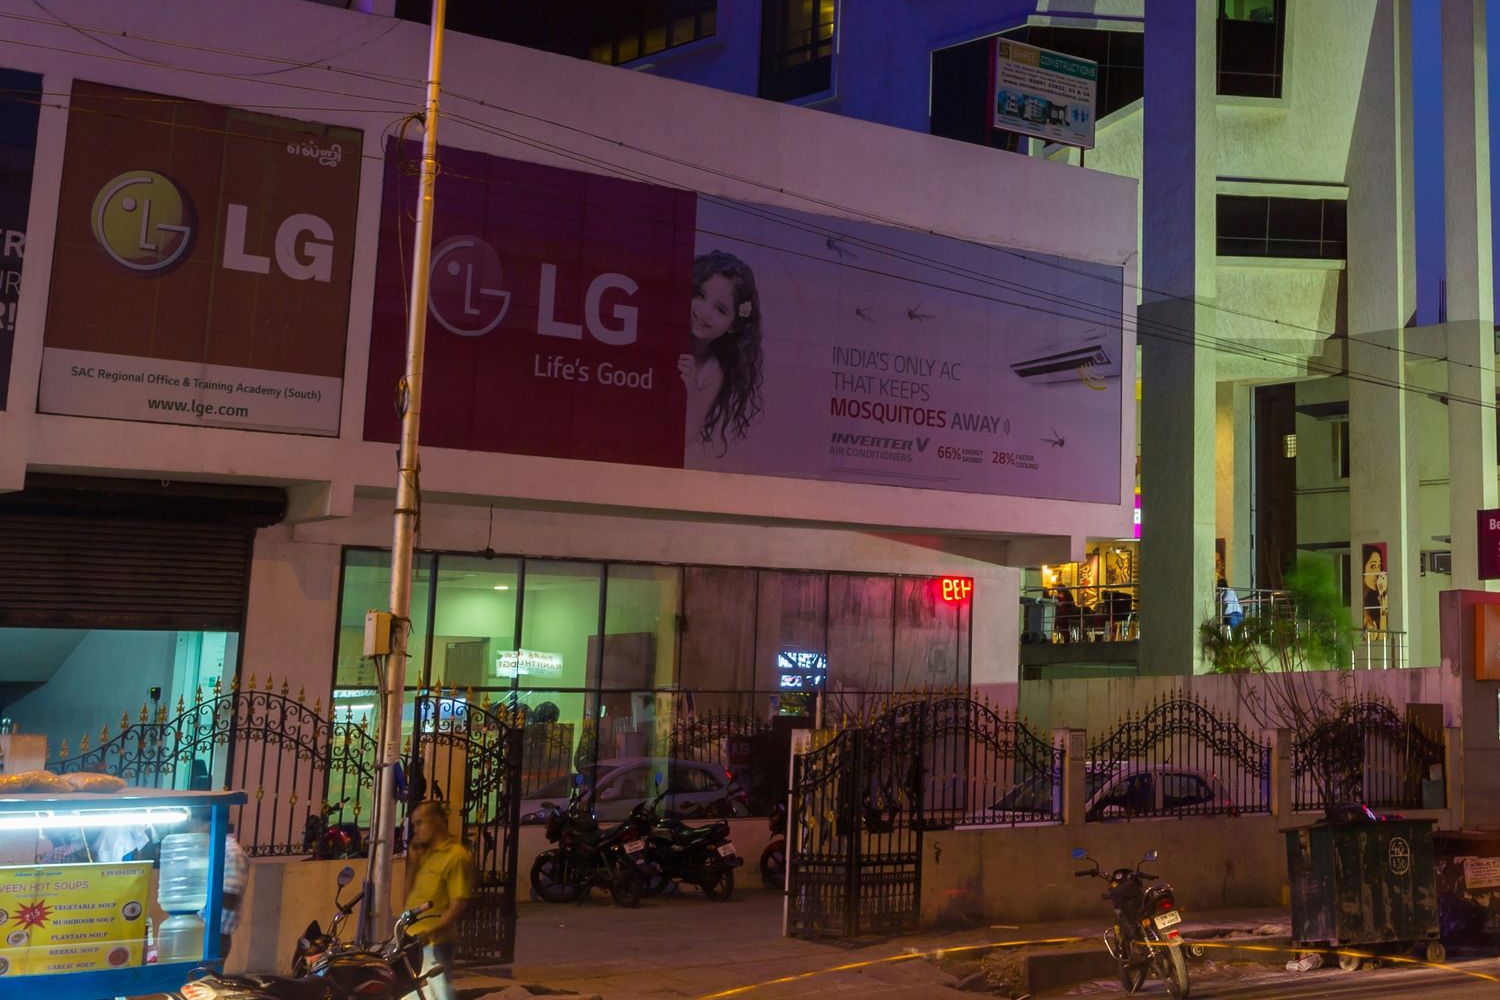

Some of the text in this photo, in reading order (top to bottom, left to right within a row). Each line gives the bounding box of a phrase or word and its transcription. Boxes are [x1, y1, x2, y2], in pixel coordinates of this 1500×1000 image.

[222, 203, 334, 283] LG
[537, 262, 640, 346] LG
[534, 354, 653, 390] Life's Good
[831, 346, 962, 381] INDIA'S ONLY AC
[71, 366, 322, 402] SAC Regional Office & Training Academy (South)
[832, 371, 930, 402] THAT KEEPS
[147, 398, 249, 418] www.lge.com
[830, 397, 1001, 435] MOSQUITOES AWAY
[830, 432, 931, 453] INVERTER V
[847, 447, 913, 463] CONDITIONERS
[937, 446, 961, 460] 66%
[992, 451, 1015, 466] 28%
[30, 882, 51, 892] HOT
[54, 880, 89, 891] SOUPS
[54, 903, 97, 911] VEGETABLE
[52, 918, 94, 926] MUSHROOM
[51, 933, 87, 941] PLANTAIN
